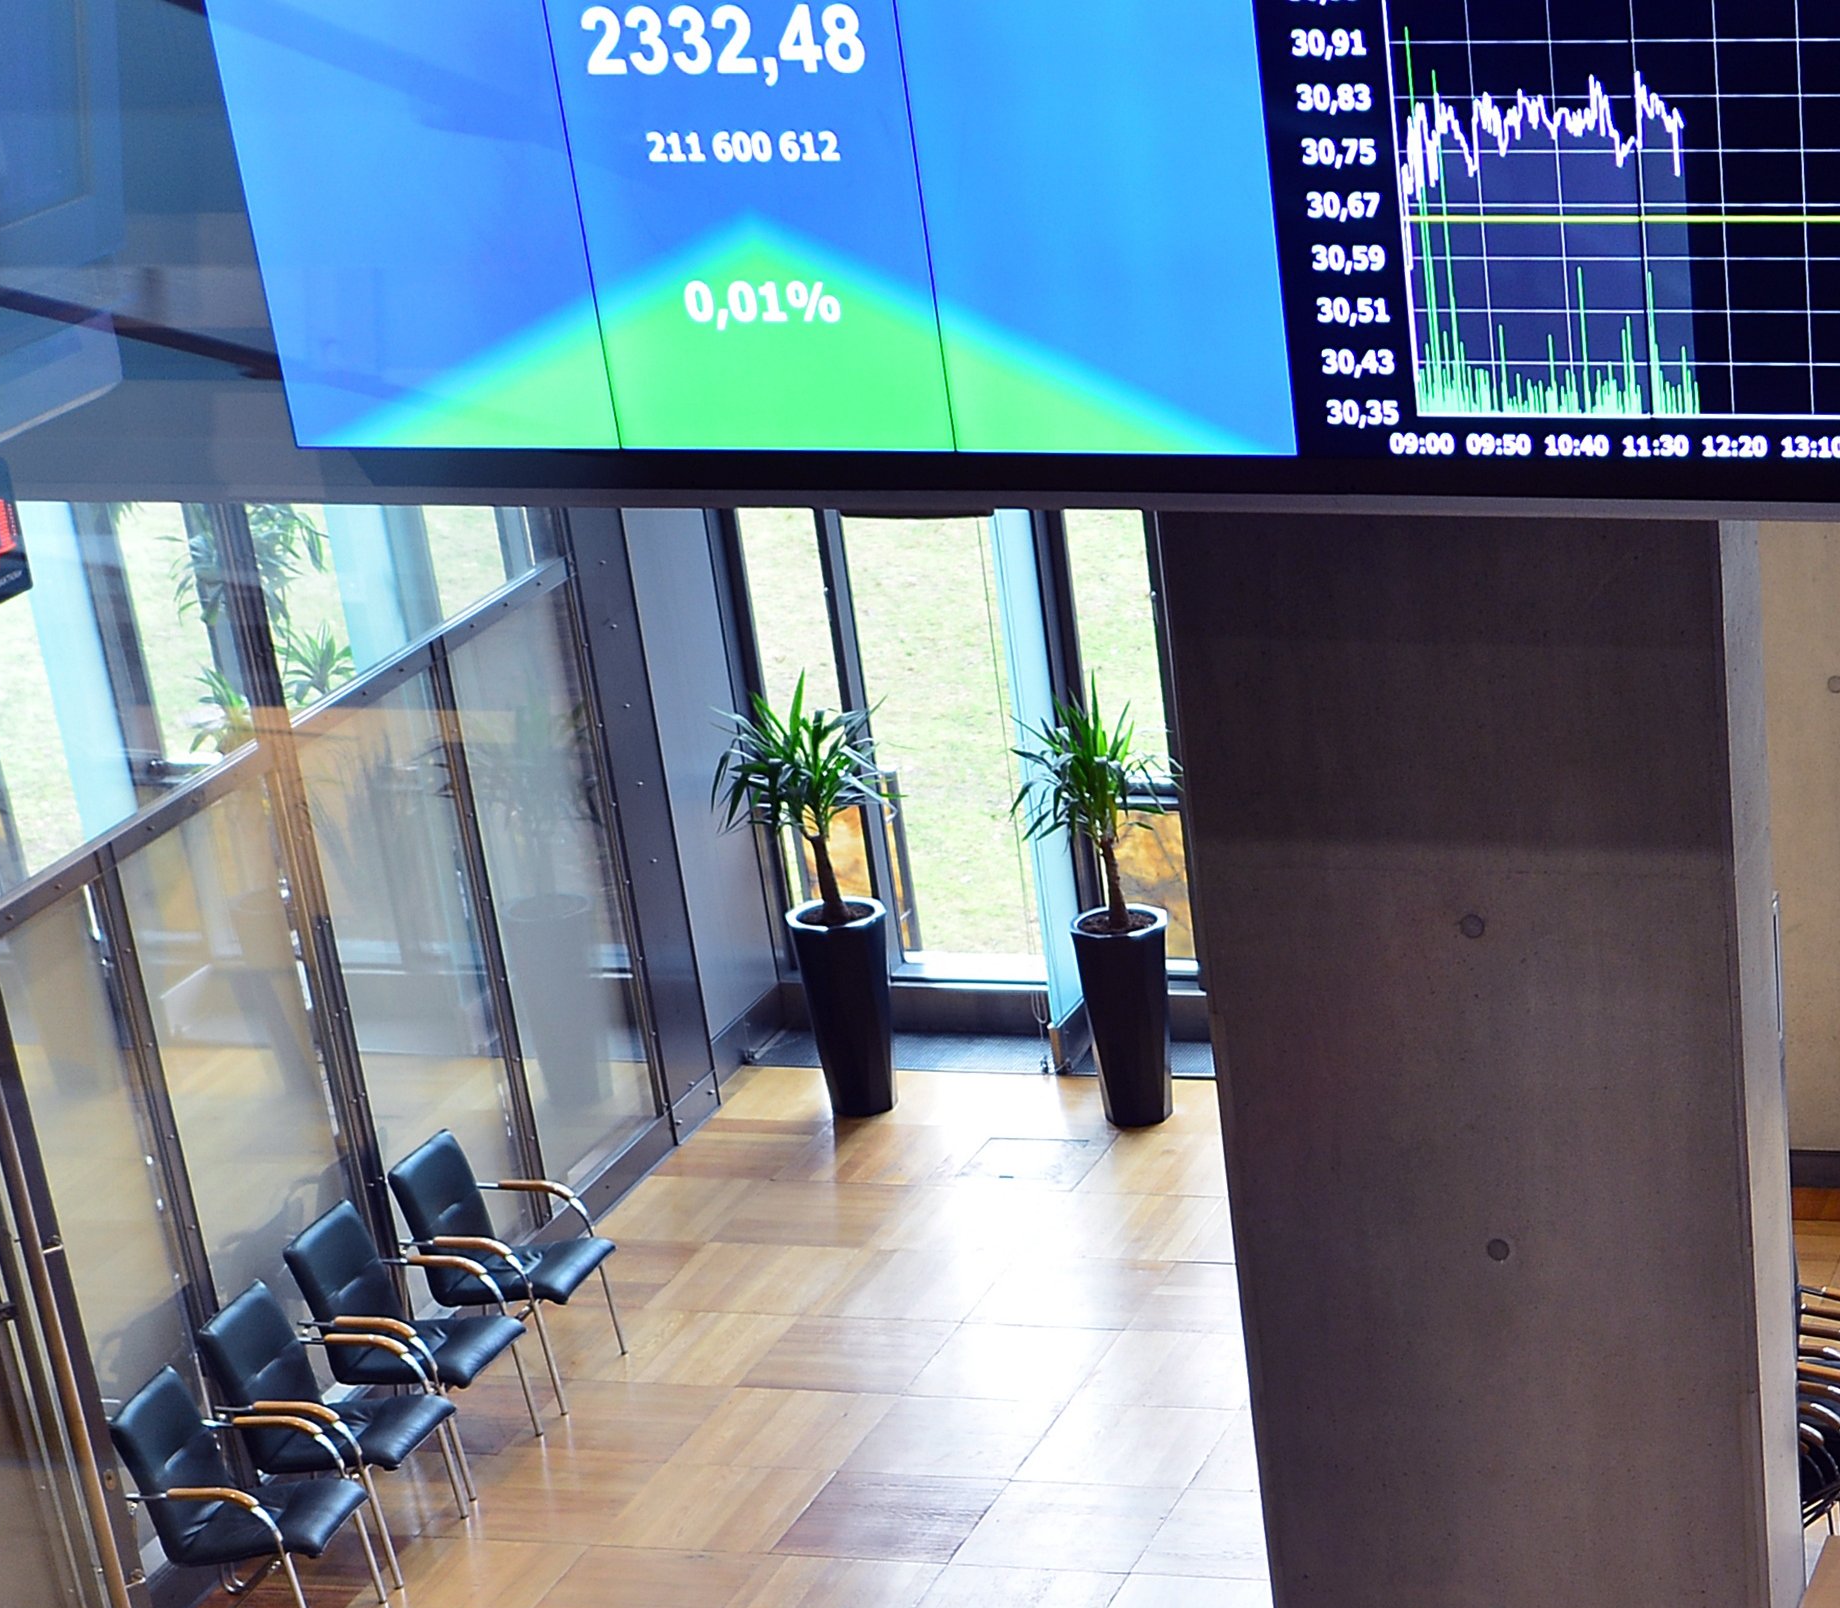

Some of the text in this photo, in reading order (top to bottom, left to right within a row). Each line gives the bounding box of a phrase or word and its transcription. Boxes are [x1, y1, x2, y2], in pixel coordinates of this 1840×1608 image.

[580, 3, 866, 87] 2332,48
[1290, 28, 1367, 61] 30,91
[1296, 83, 1372, 116] 30,83
[646, 130, 841, 163] 211 600 612
[1301, 137, 1377, 169] 30,75
[1306, 191, 1380, 223] 30,67
[1311, 244, 1386, 275] 30,59
[684, 280, 841, 331] 0,01%
[1316, 296, 1391, 327] 30,51
[1321, 348, 1395, 379] 30,43
[1326, 399, 1400, 429] 30,35
[1389, 432, 1455, 455] 09:00
[1465, 433, 1532, 456] 09:50
[1544, 433, 1610, 457] 10:40
[1622, 434, 1689, 457] 11:30
[1701, 434, 1768, 458] 12:20
